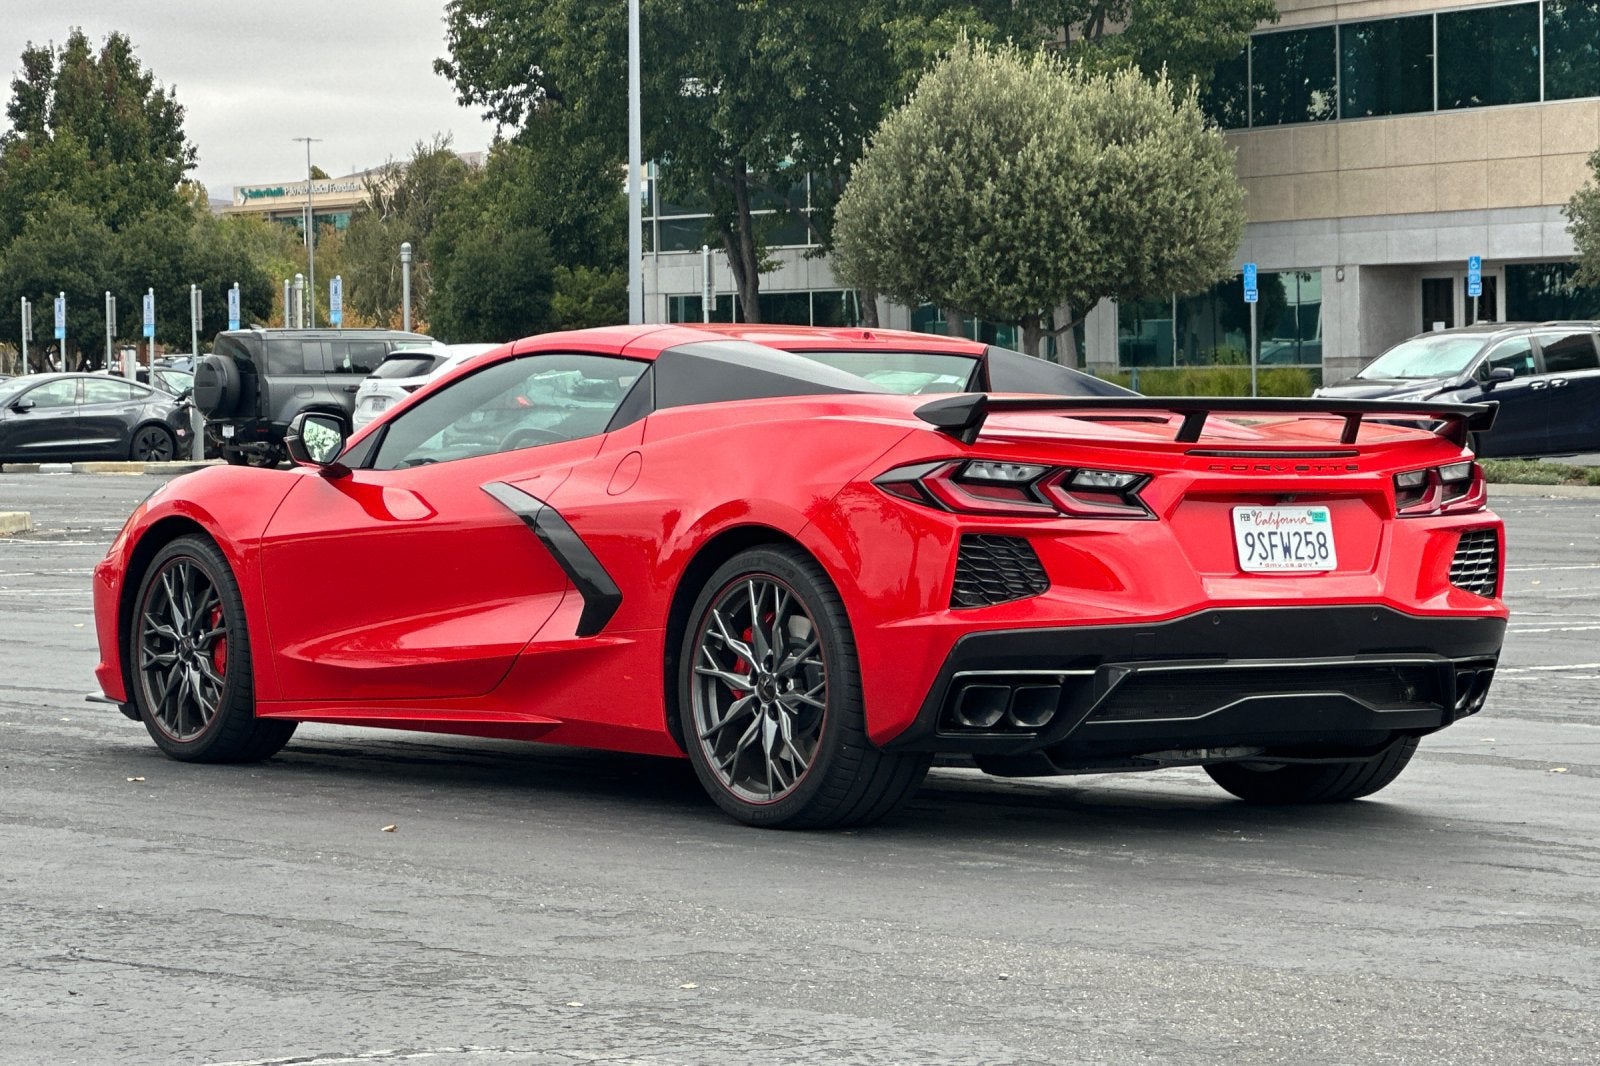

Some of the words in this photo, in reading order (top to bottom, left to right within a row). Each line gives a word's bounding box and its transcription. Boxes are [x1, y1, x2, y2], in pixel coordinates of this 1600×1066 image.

[1240, 514, 1251, 523] FEB
[1255, 511, 1313, 529] California
[1244, 531, 1329, 561] 9SFW258
